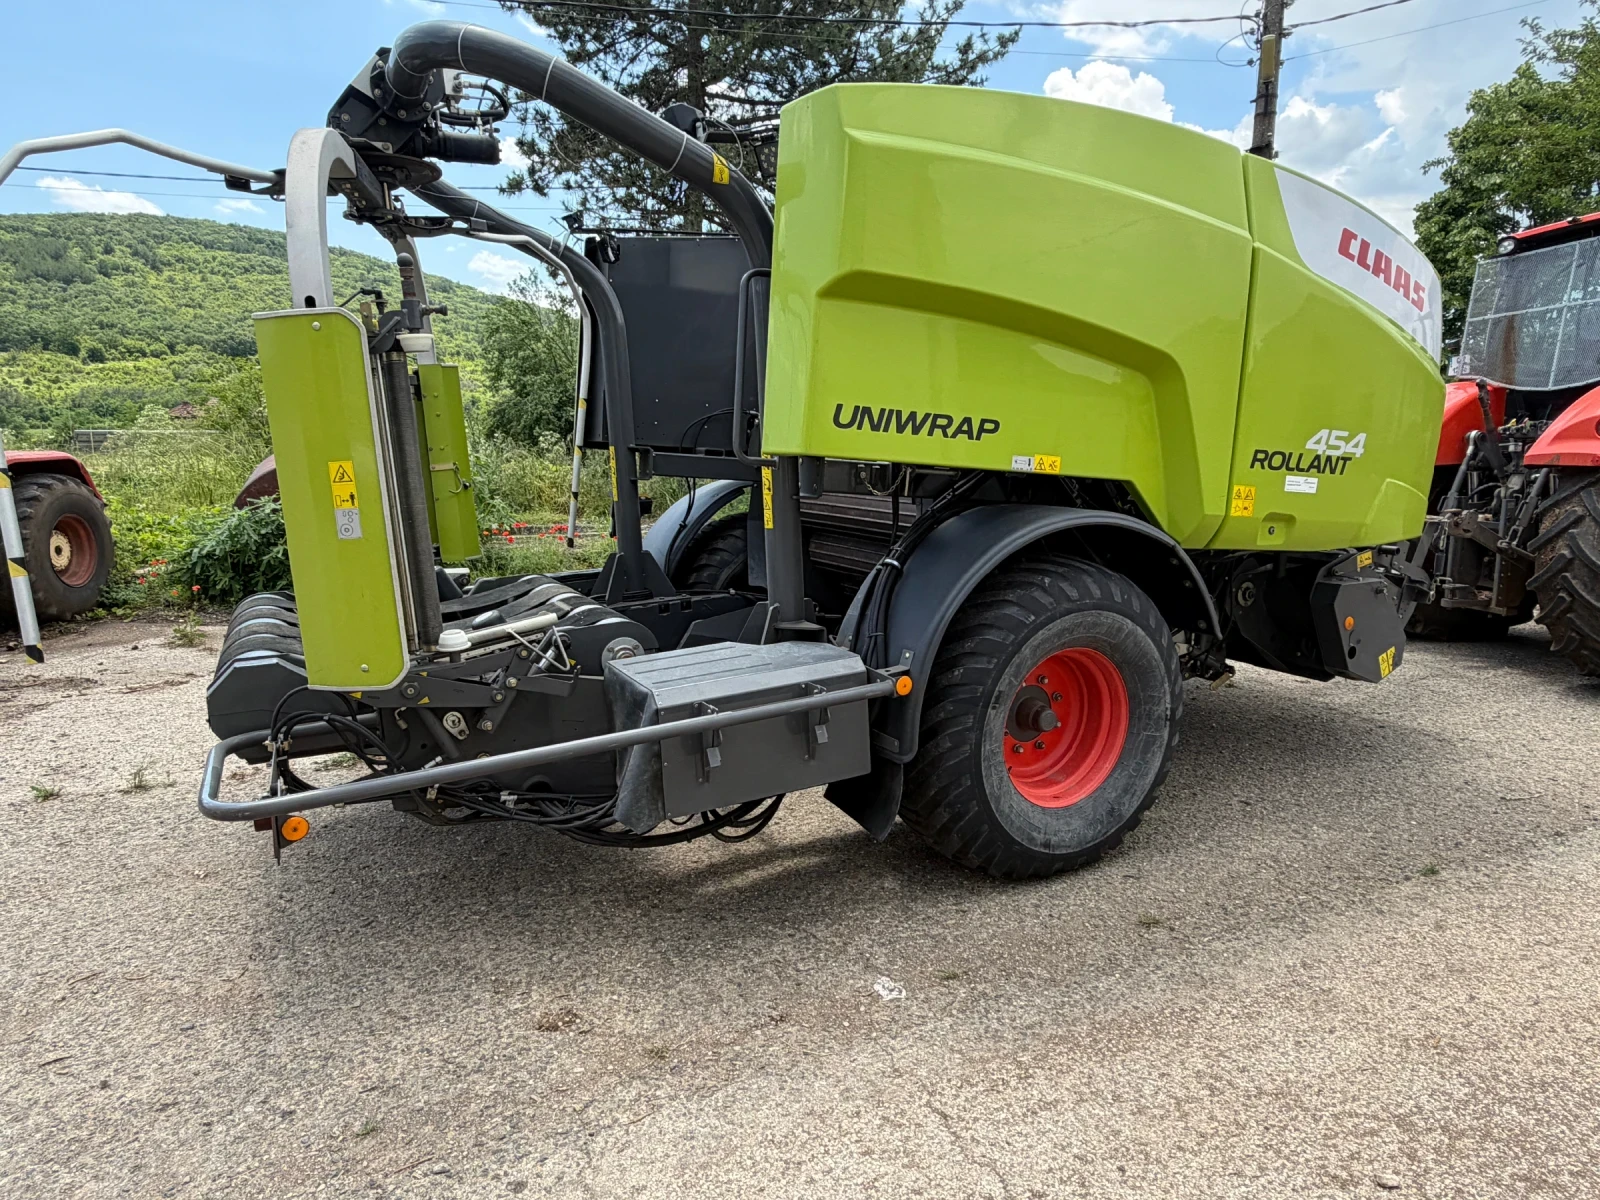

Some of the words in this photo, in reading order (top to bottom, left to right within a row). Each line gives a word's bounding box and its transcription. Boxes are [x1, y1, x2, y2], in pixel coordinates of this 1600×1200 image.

[1338, 227, 1426, 312] CLAAS
[832, 403, 1001, 441] UNIWRAP
[1305, 428, 1367, 458] 454
[1249, 448, 1353, 475] ROLLANT
